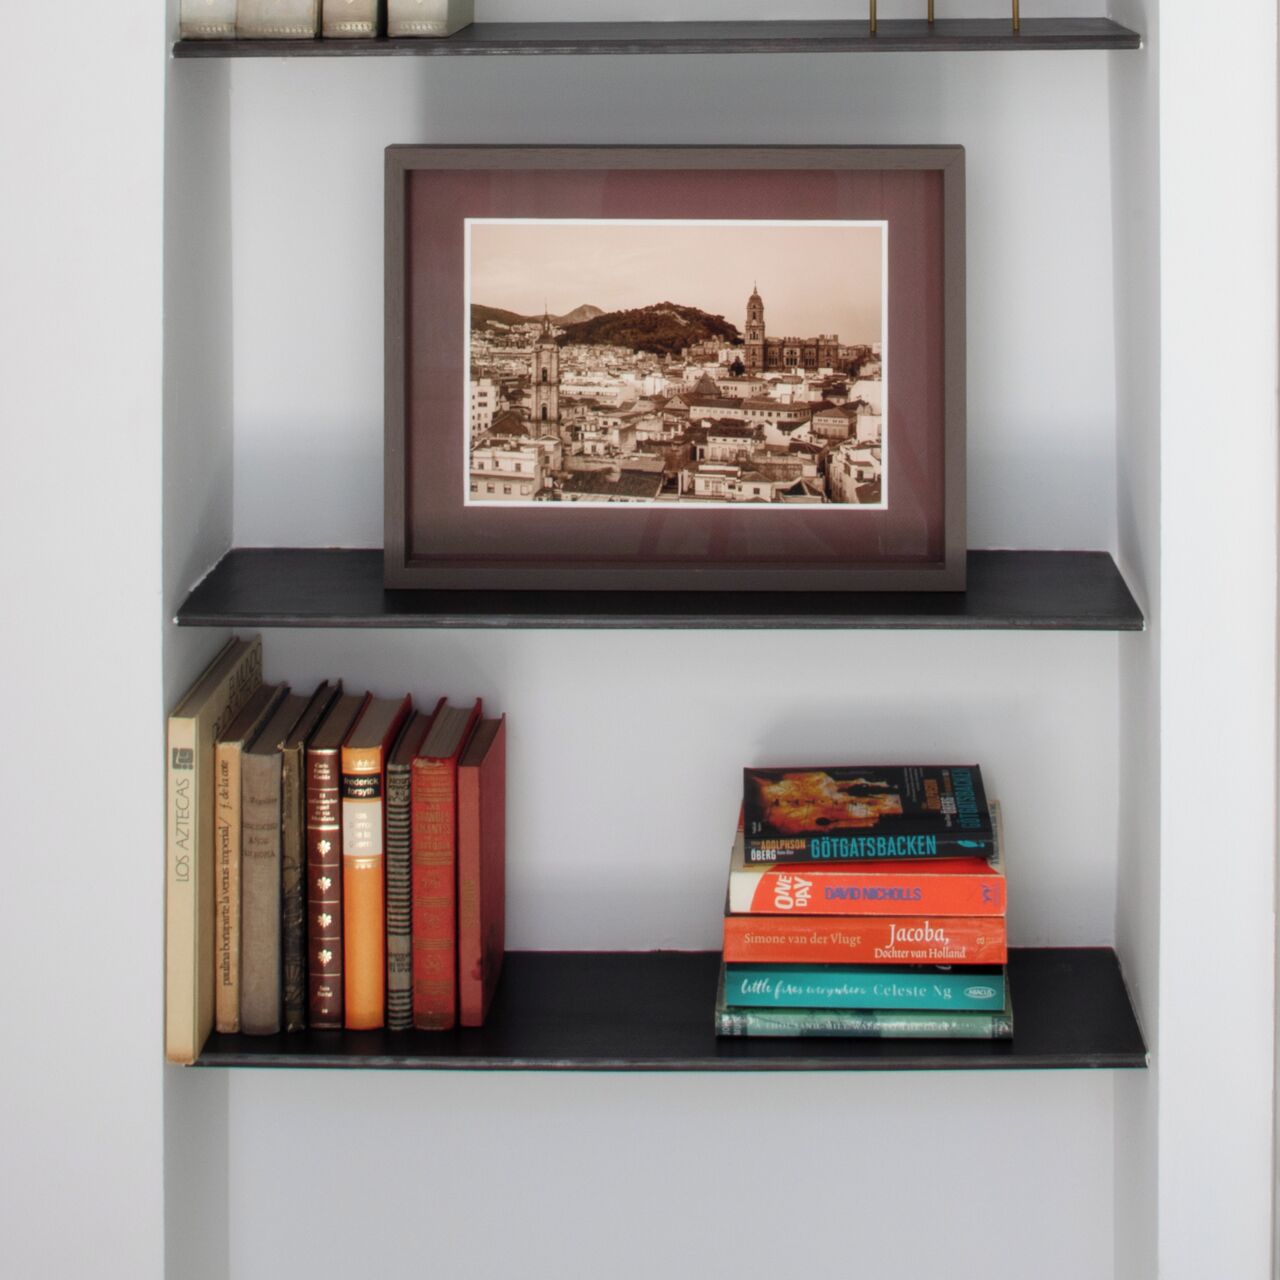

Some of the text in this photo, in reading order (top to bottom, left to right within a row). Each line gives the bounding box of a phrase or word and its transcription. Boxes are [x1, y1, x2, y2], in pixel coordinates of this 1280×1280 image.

[348, 787, 375, 797] forsyth
[176, 778, 190, 882] LOS AZTECAS
[751, 848, 777, 861] ÖBERG
[810, 834, 937, 859] GÖTGATSBACKEN
[774, 874, 794, 910] ONE
[794, 876, 813, 907] DAY
[824, 886, 922, 901] DAVID NICHOLLS
[744, 932, 862, 948] Simone van der Vlugt
[885, 920, 950, 949] Jacoba,
[874, 946, 967, 959] Dochter van Holland
[873, 984, 952, 1000] Celeste Ng
